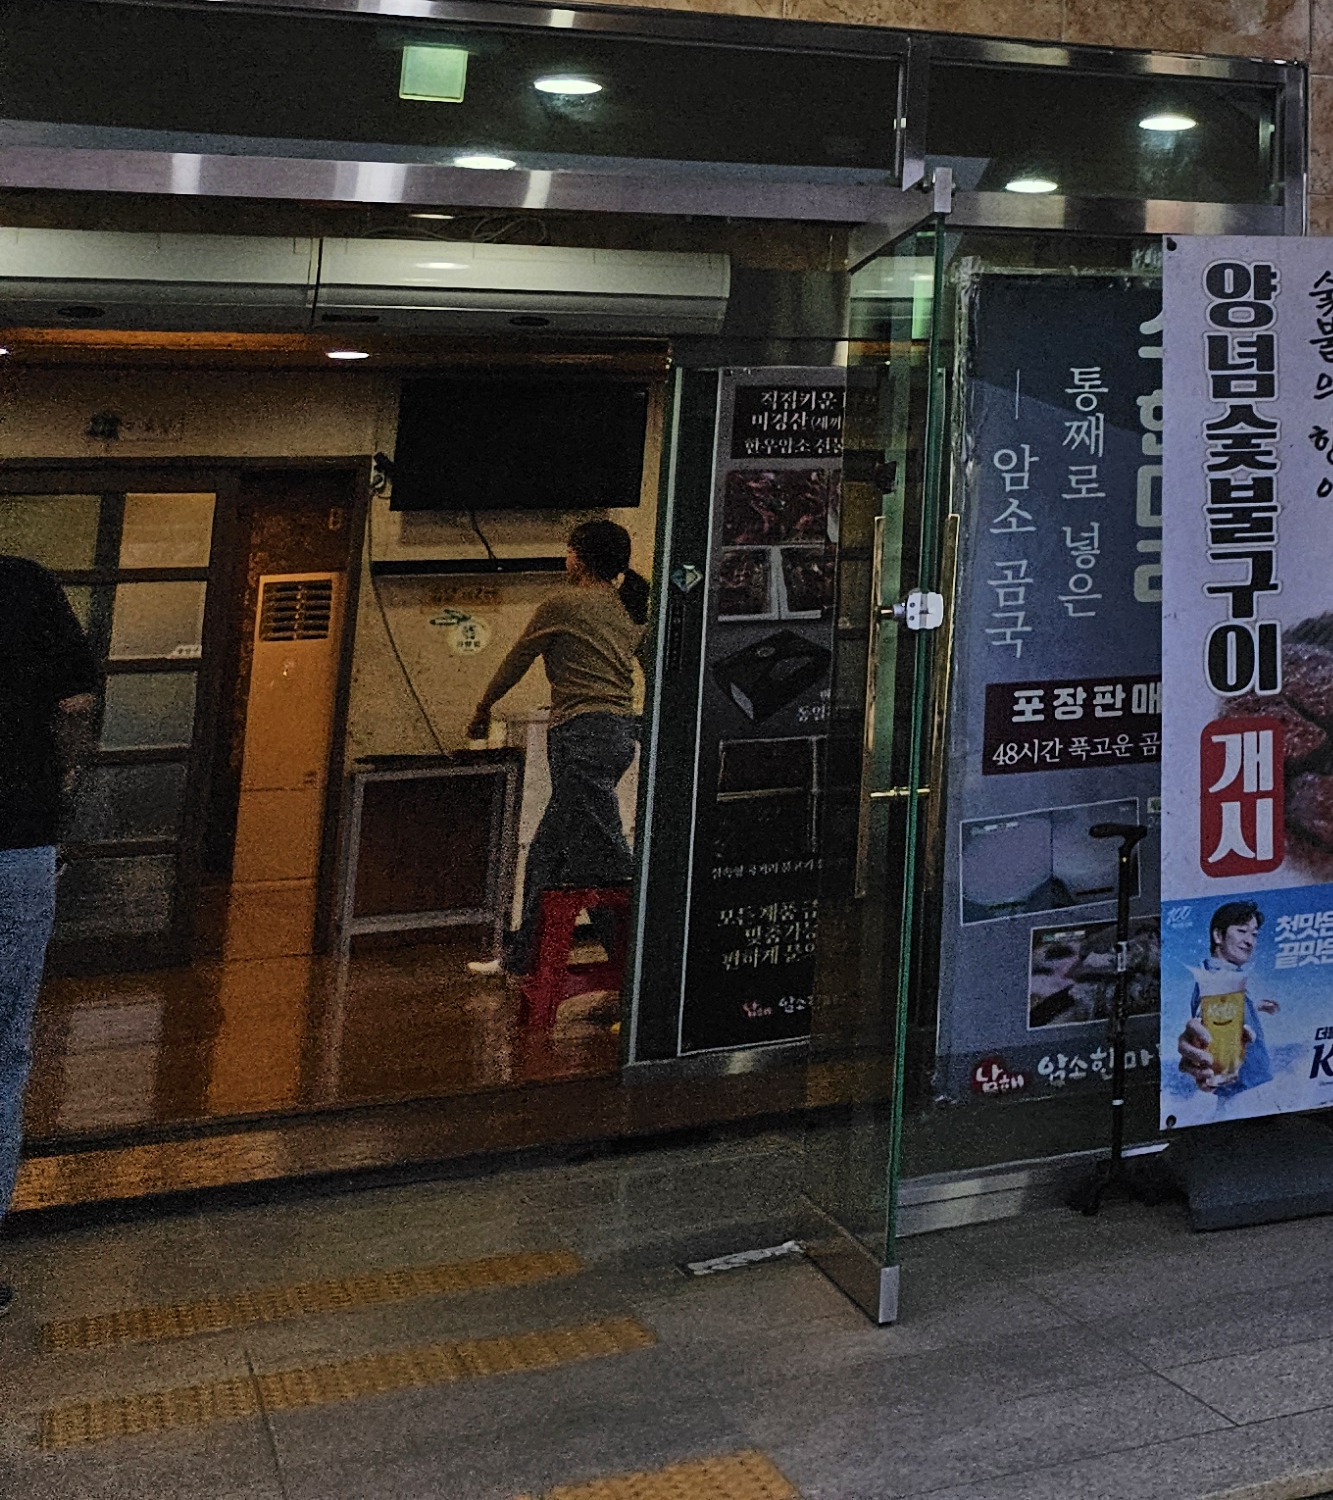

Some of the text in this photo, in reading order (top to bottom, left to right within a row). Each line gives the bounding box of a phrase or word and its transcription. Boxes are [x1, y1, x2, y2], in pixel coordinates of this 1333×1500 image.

[1057, 364, 1109, 618] 통째로 넣은
[1204, 258, 1282, 698] 양념숯불구이
[984, 443, 1040, 659] 암소 곰국
[992, 737, 1063, 766] 48시간
[1012, 680, 1161, 723] 포장판매
[1207, 728, 1278, 864] 개시
[1037, 1043, 1161, 1088] 암소한마
